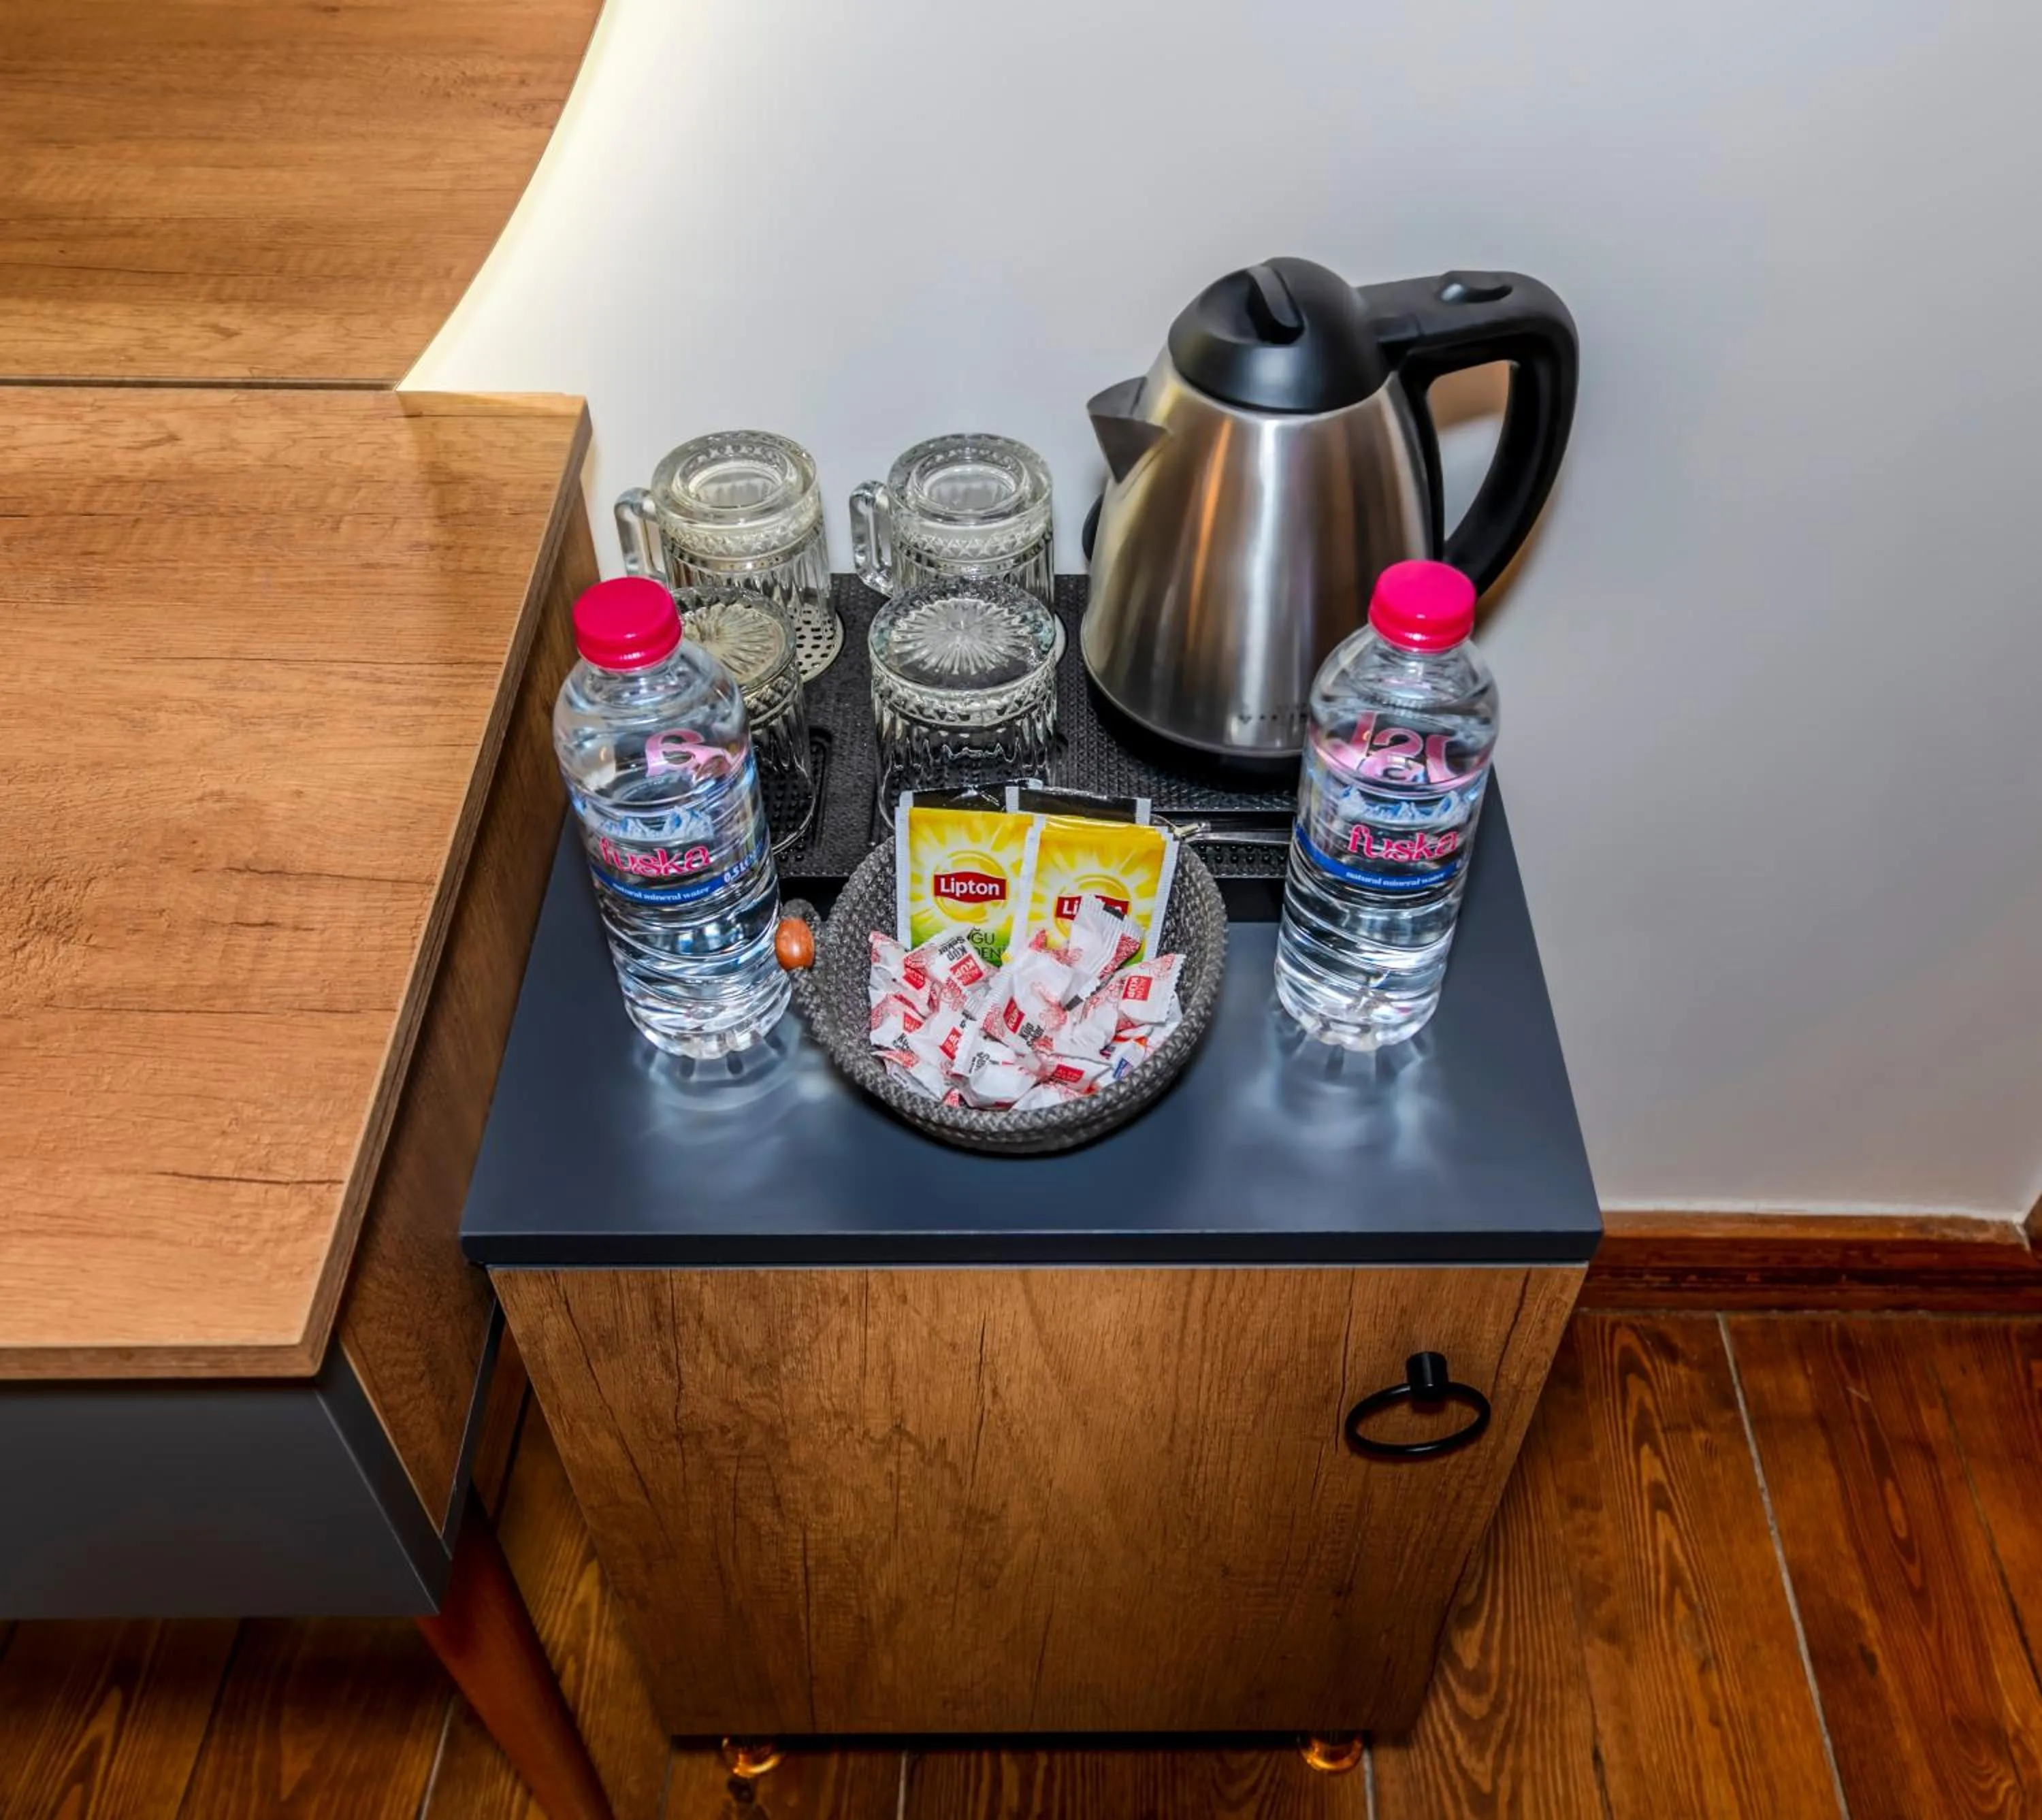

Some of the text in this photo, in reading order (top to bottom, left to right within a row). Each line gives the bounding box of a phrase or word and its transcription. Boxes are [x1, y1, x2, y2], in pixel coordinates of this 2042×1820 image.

[599, 837, 711, 876] fuska
[1348, 823, 1460, 862] fuska
[939, 877, 1000, 896] Lipton
